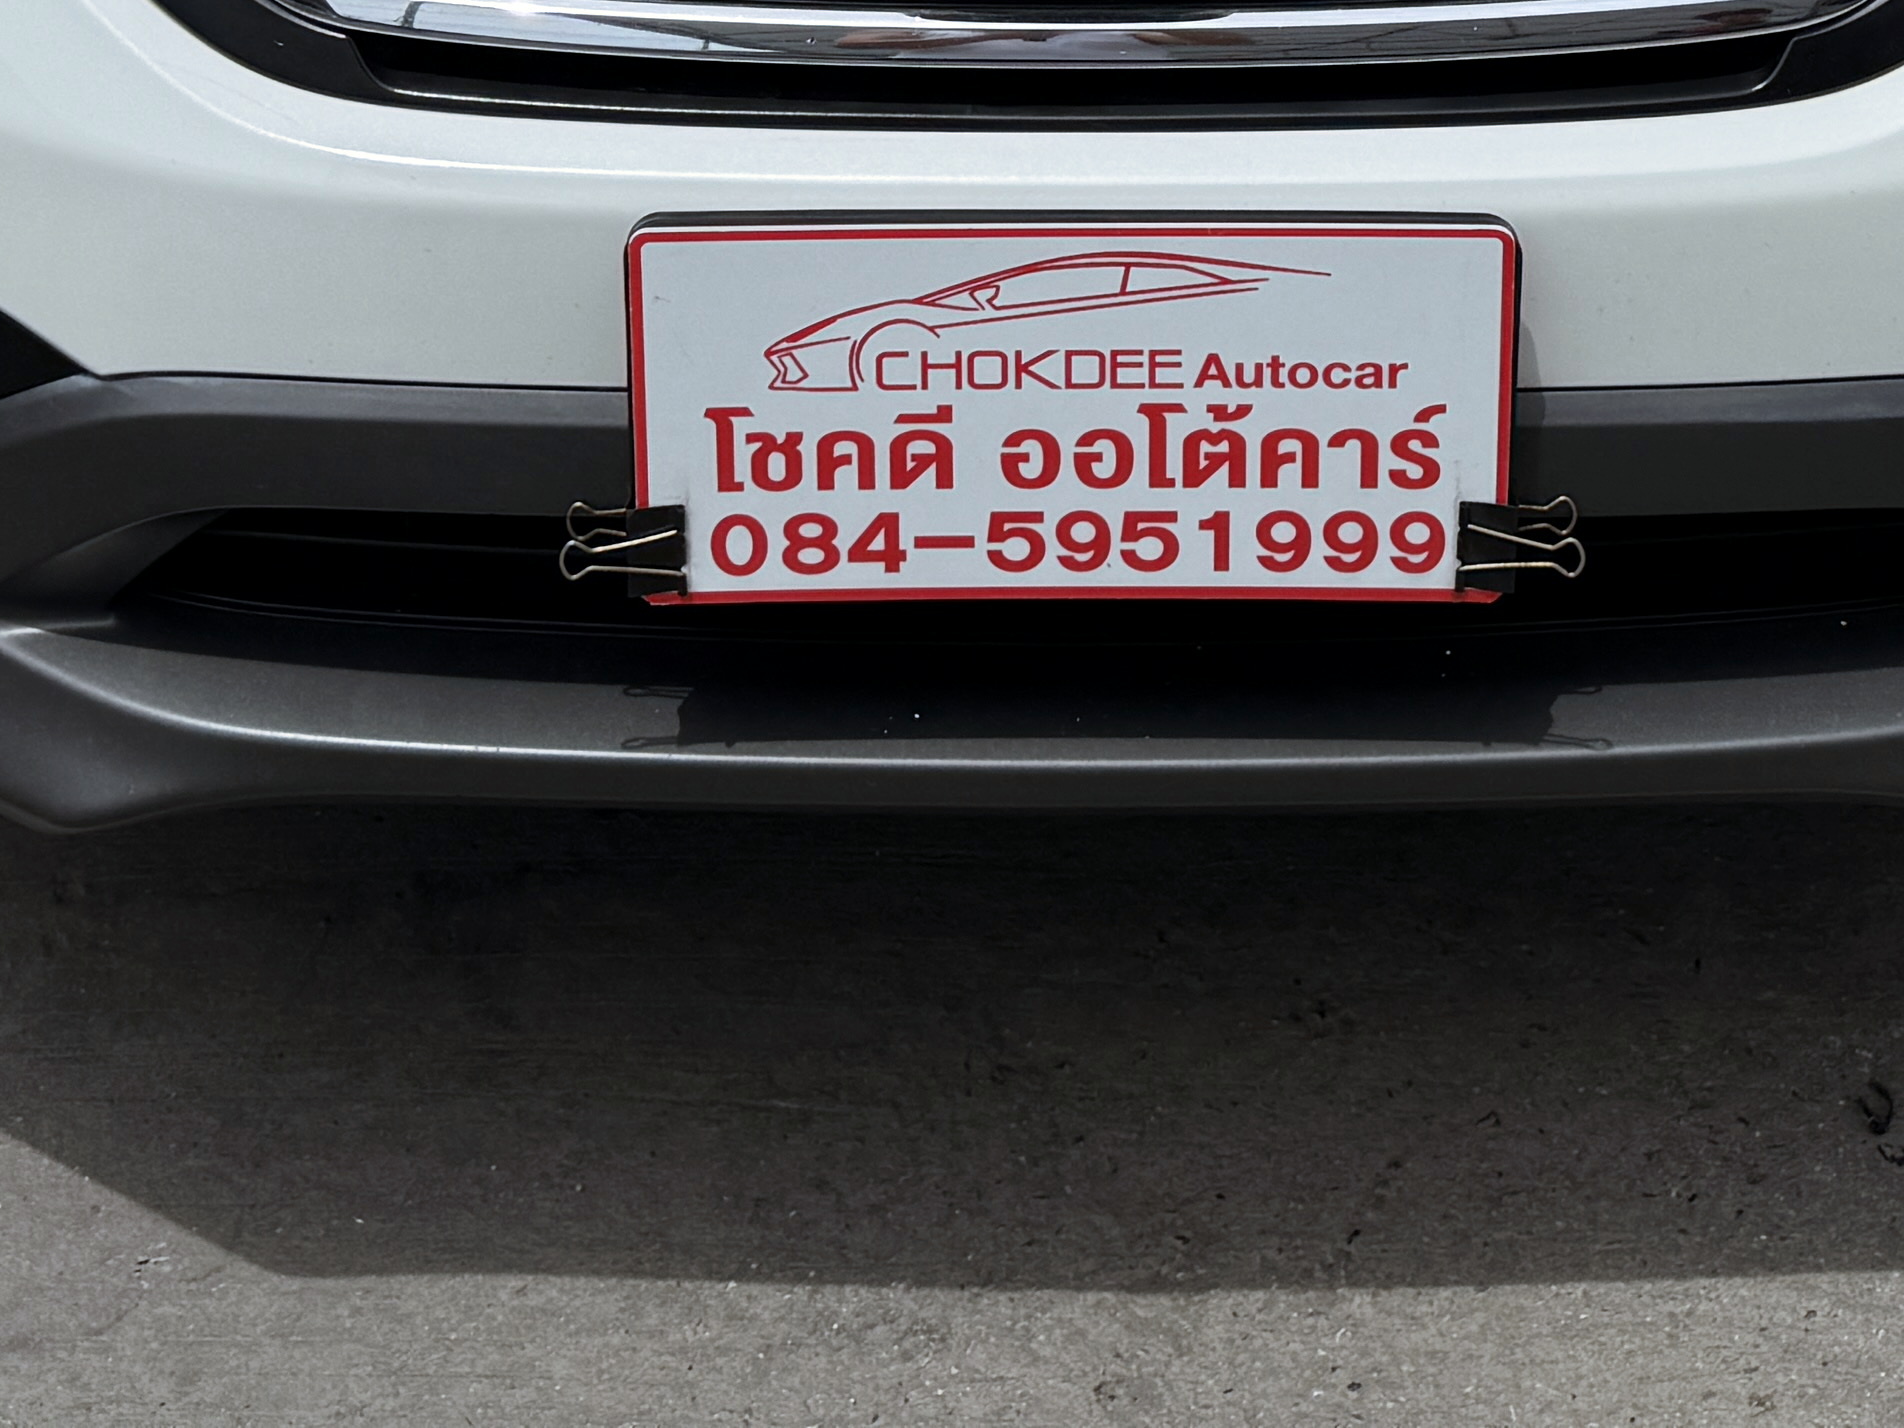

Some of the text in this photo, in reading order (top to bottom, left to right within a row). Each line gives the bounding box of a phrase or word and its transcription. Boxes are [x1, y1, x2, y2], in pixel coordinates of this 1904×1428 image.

[875, 350, 1409, 391] CHOKDEE Autocar
[704, 403, 1448, 493] โชคดี ออโต้คาร์
[710, 510, 1447, 577] 084-5951999
